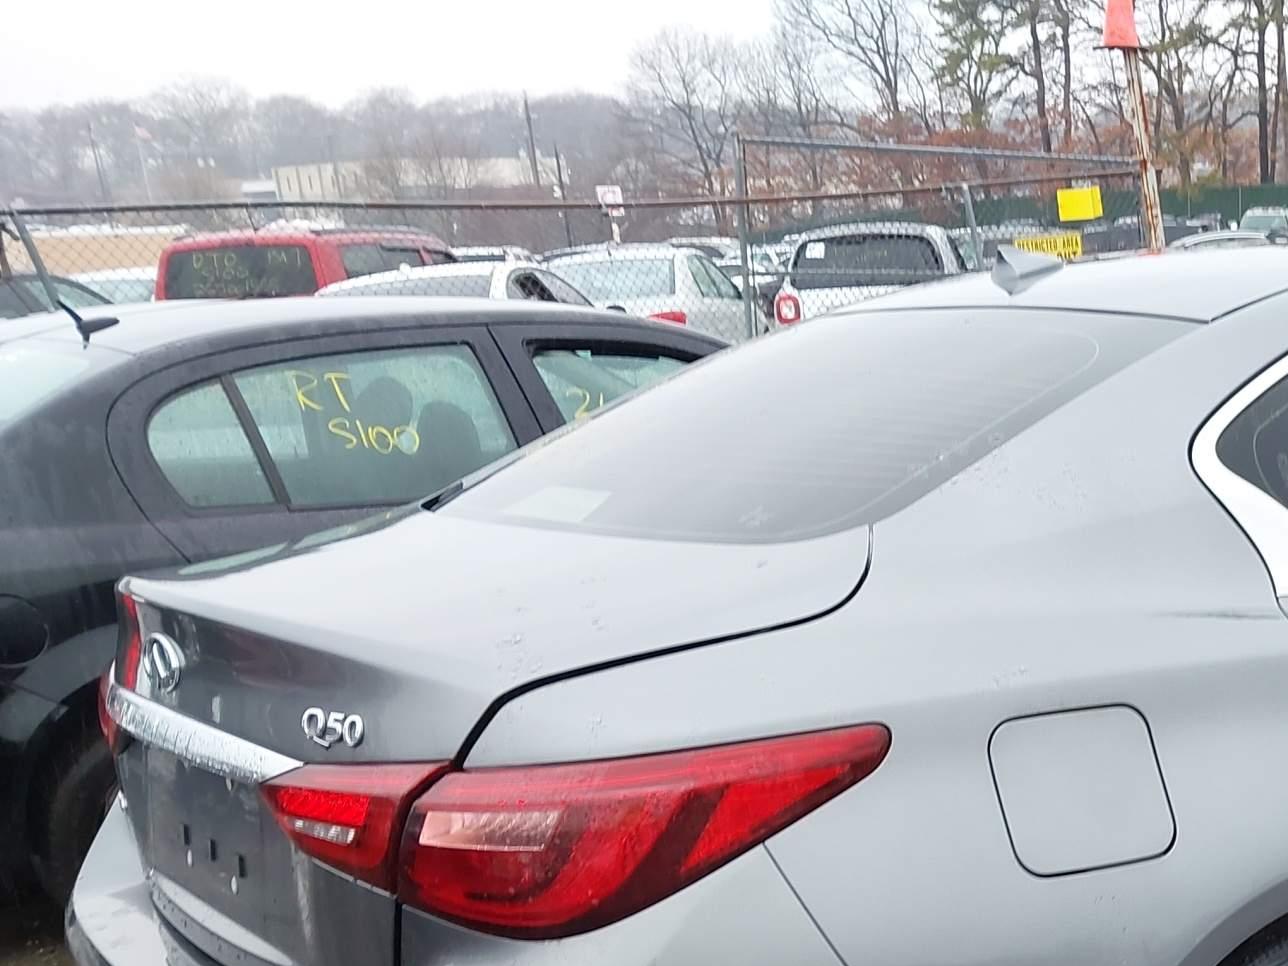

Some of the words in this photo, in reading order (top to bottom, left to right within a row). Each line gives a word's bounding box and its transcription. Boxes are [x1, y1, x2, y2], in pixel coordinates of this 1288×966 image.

[287, 370, 351, 412] RT
[328, 416, 420, 455] S100
[301, 706, 365, 748] Q50
